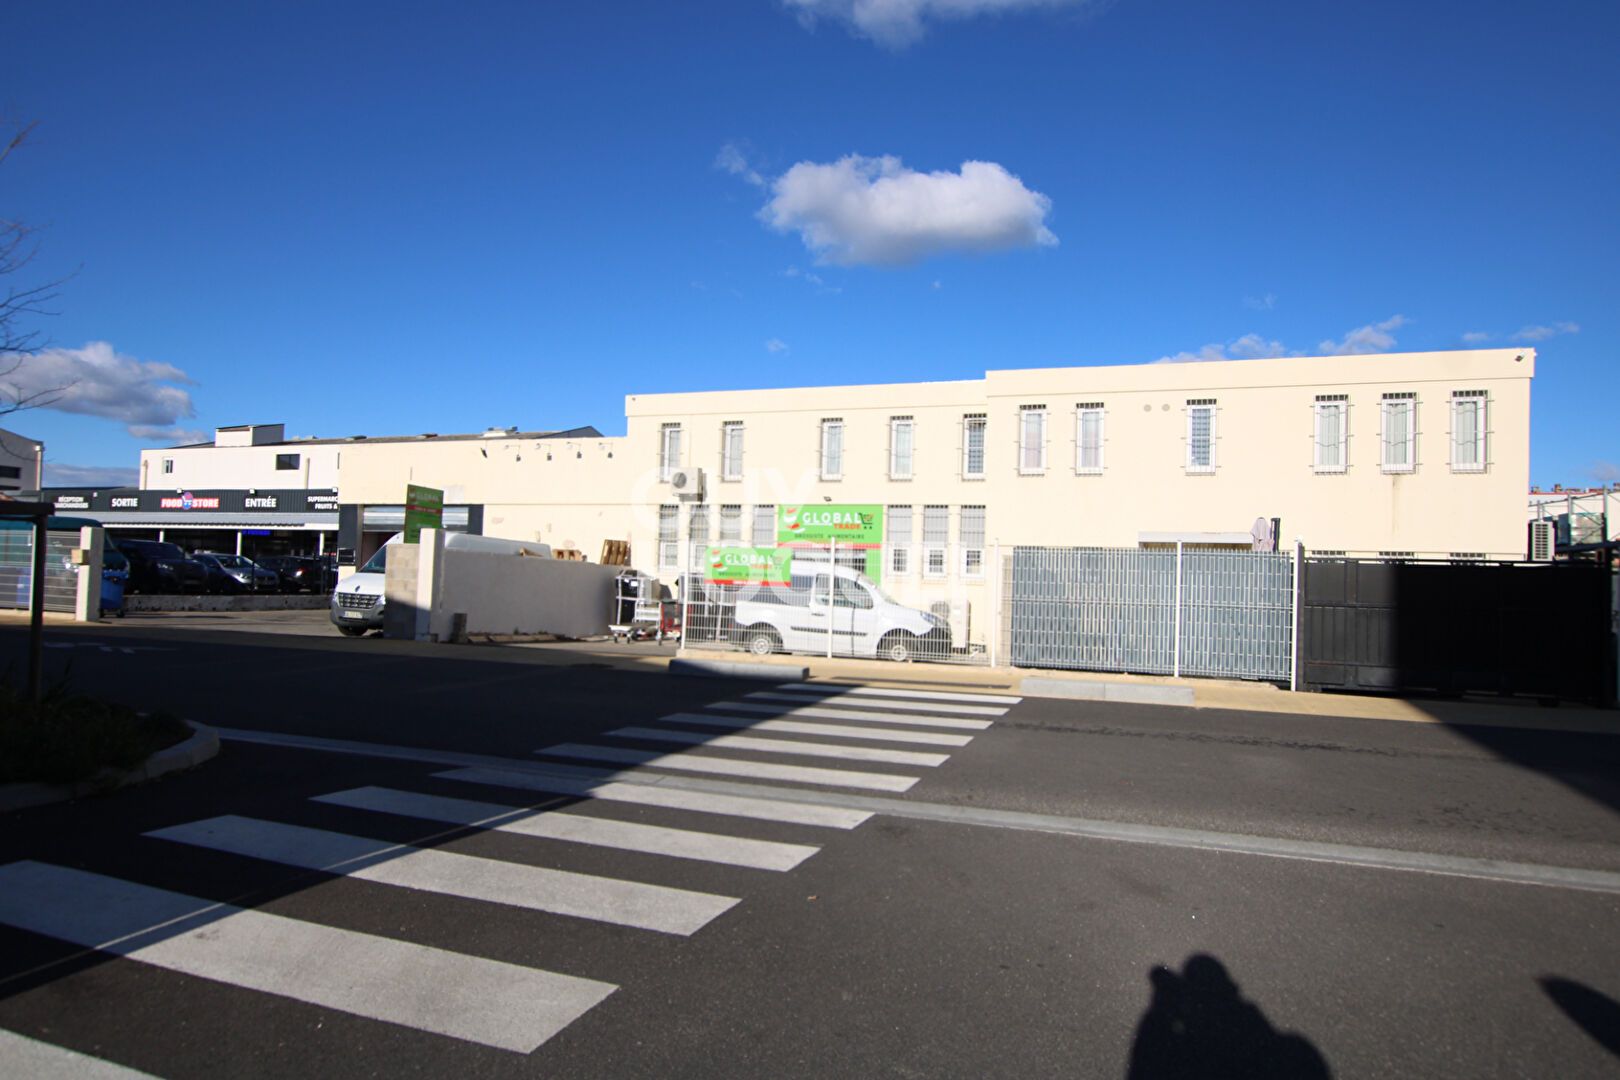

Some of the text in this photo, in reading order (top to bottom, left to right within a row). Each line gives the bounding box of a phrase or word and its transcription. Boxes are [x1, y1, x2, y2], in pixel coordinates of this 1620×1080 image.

[111, 498, 138, 507] SORTIE
[161, 498, 219, 508] FOOD STORE
[245, 496, 277, 508] ENTRÉE
[802, 512, 862, 524] GLOBAL
[725, 554, 773, 565] GLOBAL
